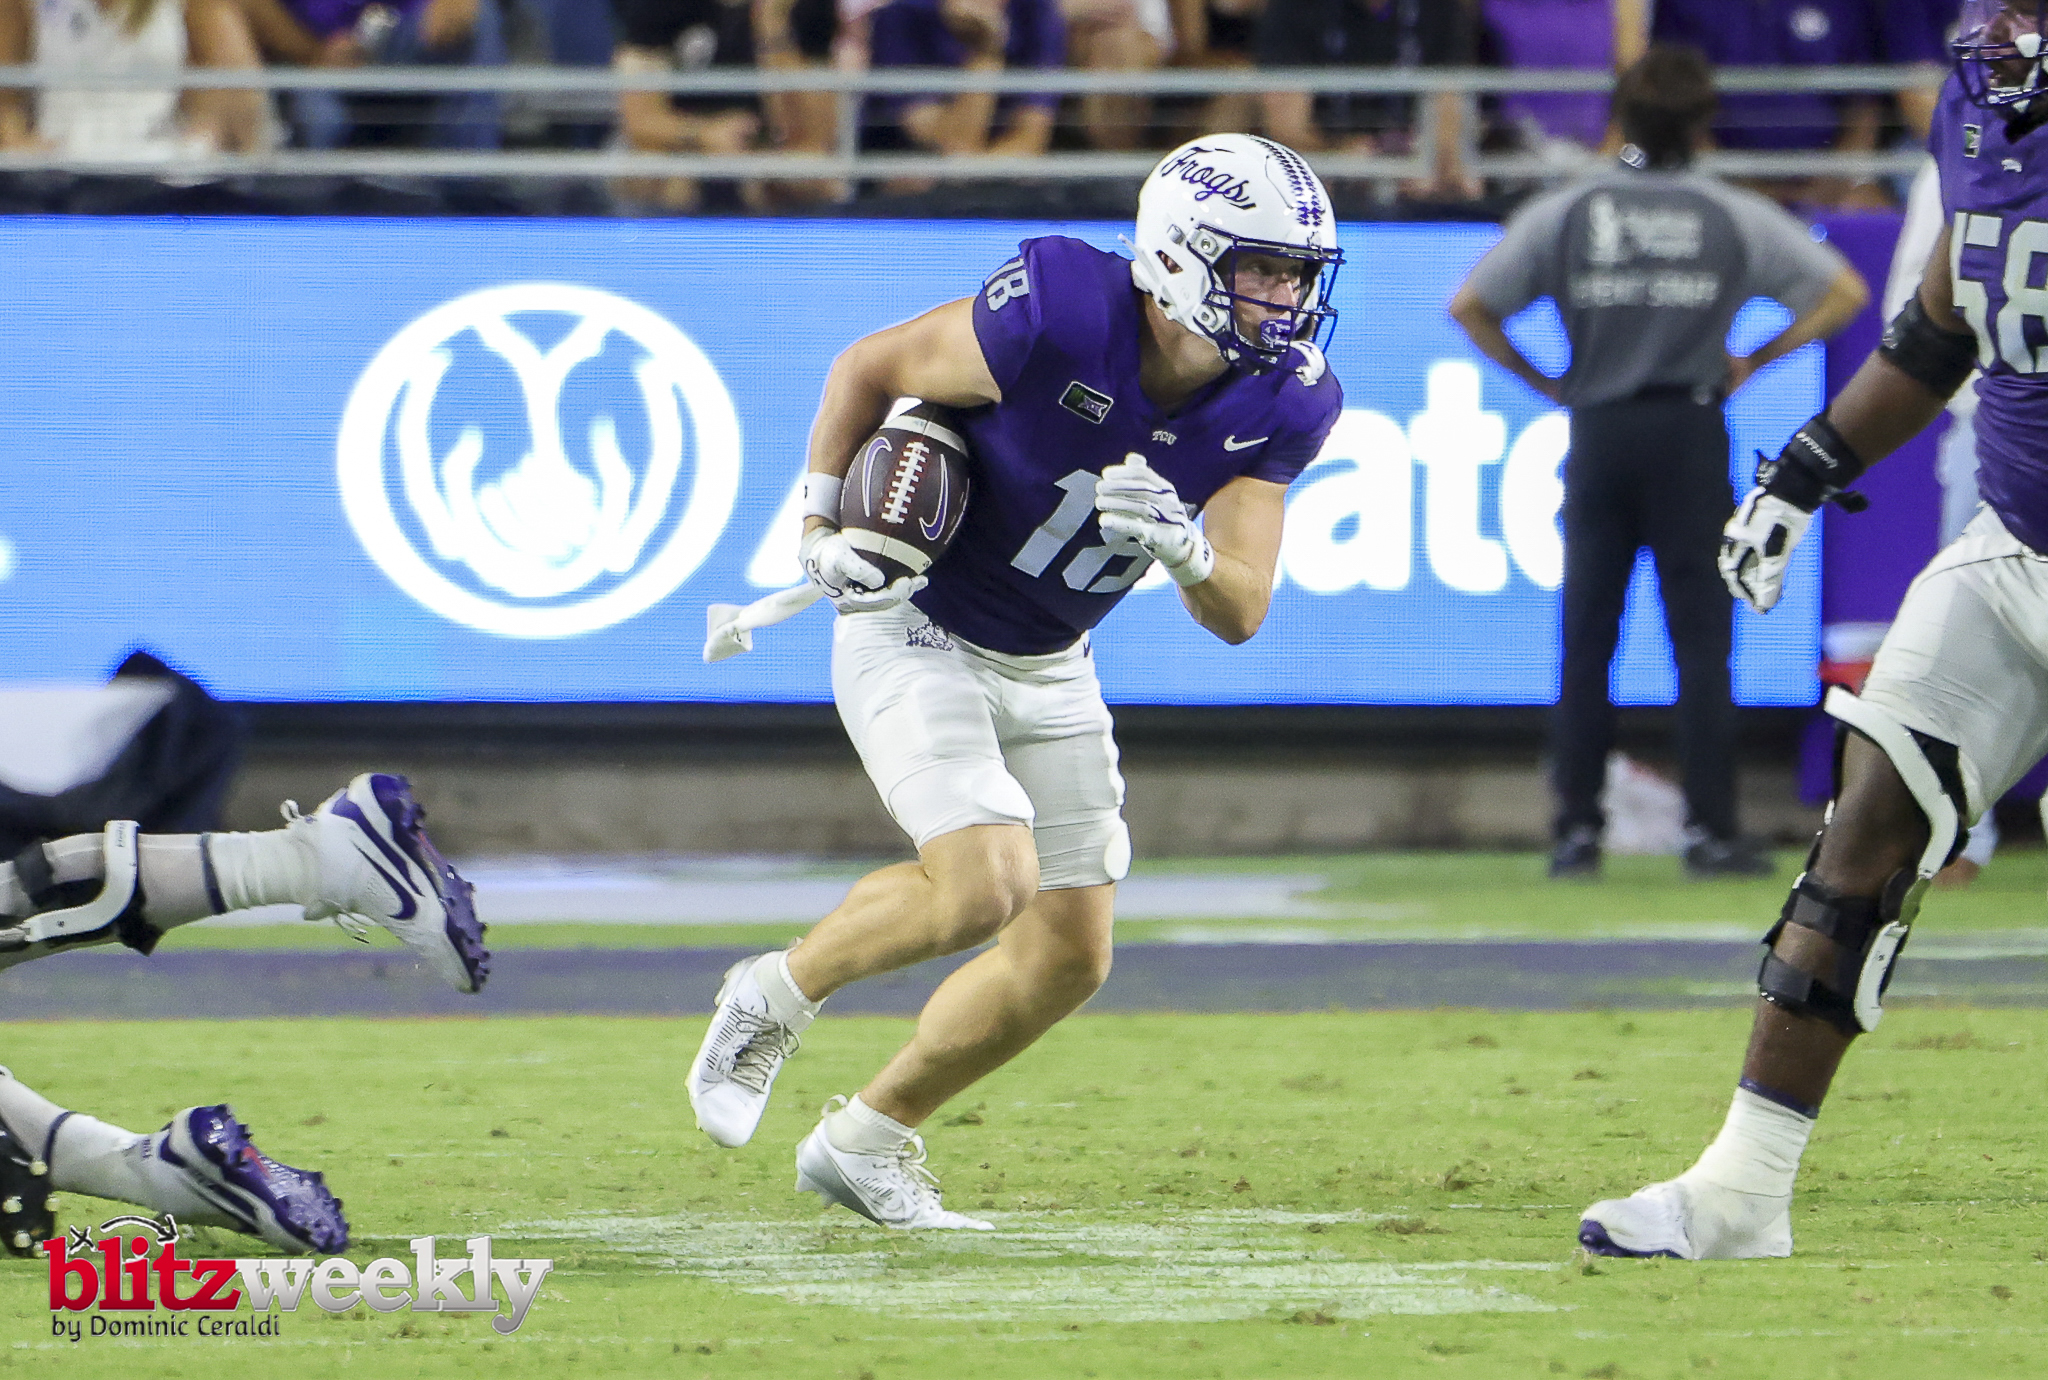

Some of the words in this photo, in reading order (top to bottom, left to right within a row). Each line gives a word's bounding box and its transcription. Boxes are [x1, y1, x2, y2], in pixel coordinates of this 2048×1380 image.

[1160, 146, 1255, 210] Frogs
[1951, 211, 2048, 374] 58
[1152, 431, 1177, 446] TCU
